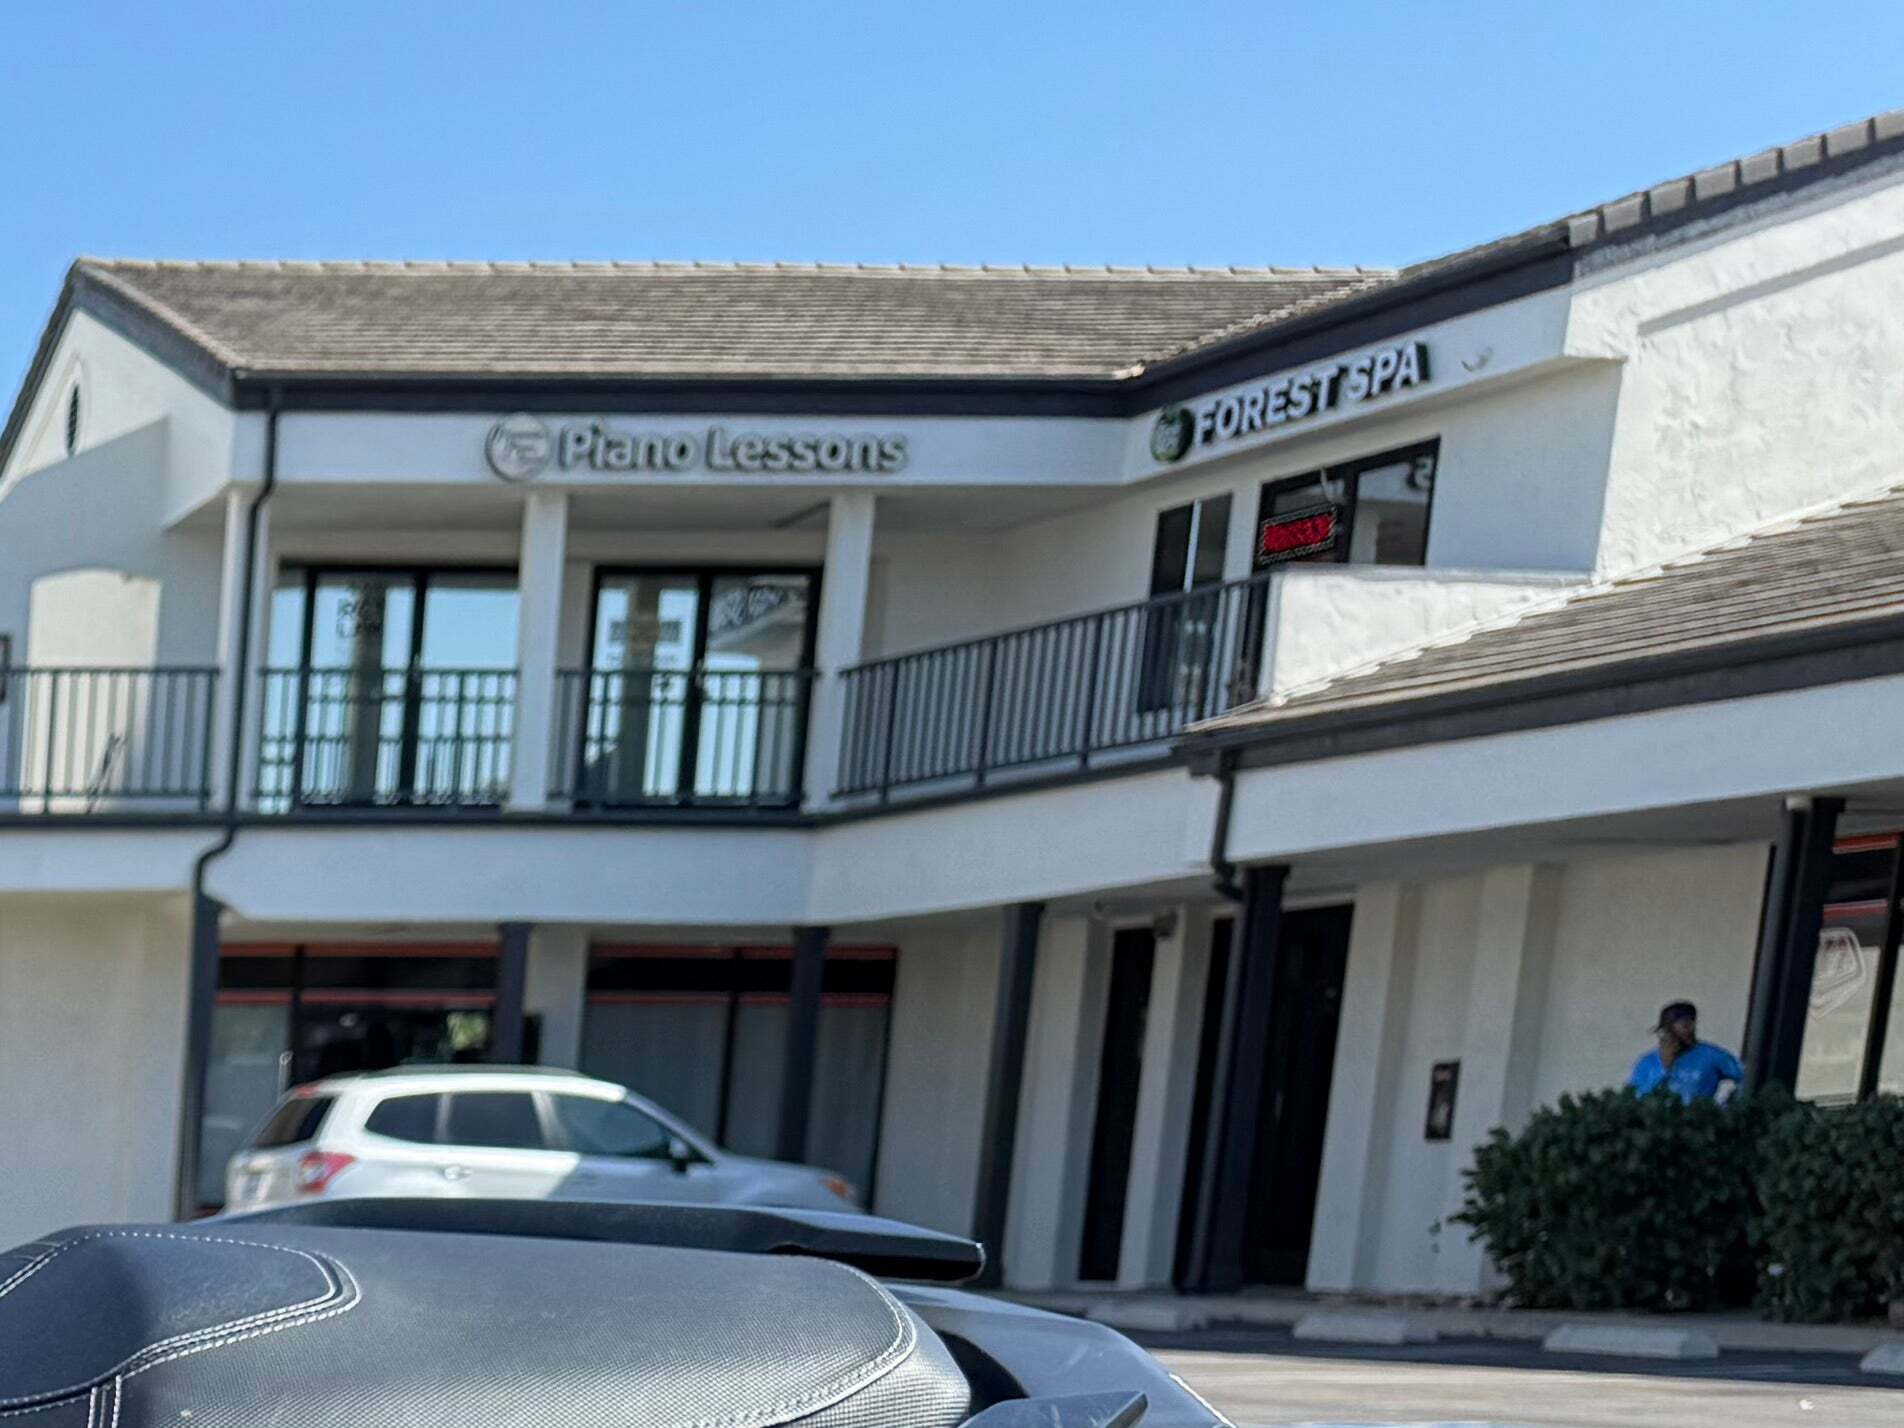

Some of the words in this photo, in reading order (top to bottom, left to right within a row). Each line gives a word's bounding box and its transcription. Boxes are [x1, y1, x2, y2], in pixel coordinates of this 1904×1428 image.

[1192, 364, 1341, 446] FOREST
[1343, 341, 1430, 400] SPA
[559, 418, 693, 471] Piano
[706, 424, 909, 472] Lessons
